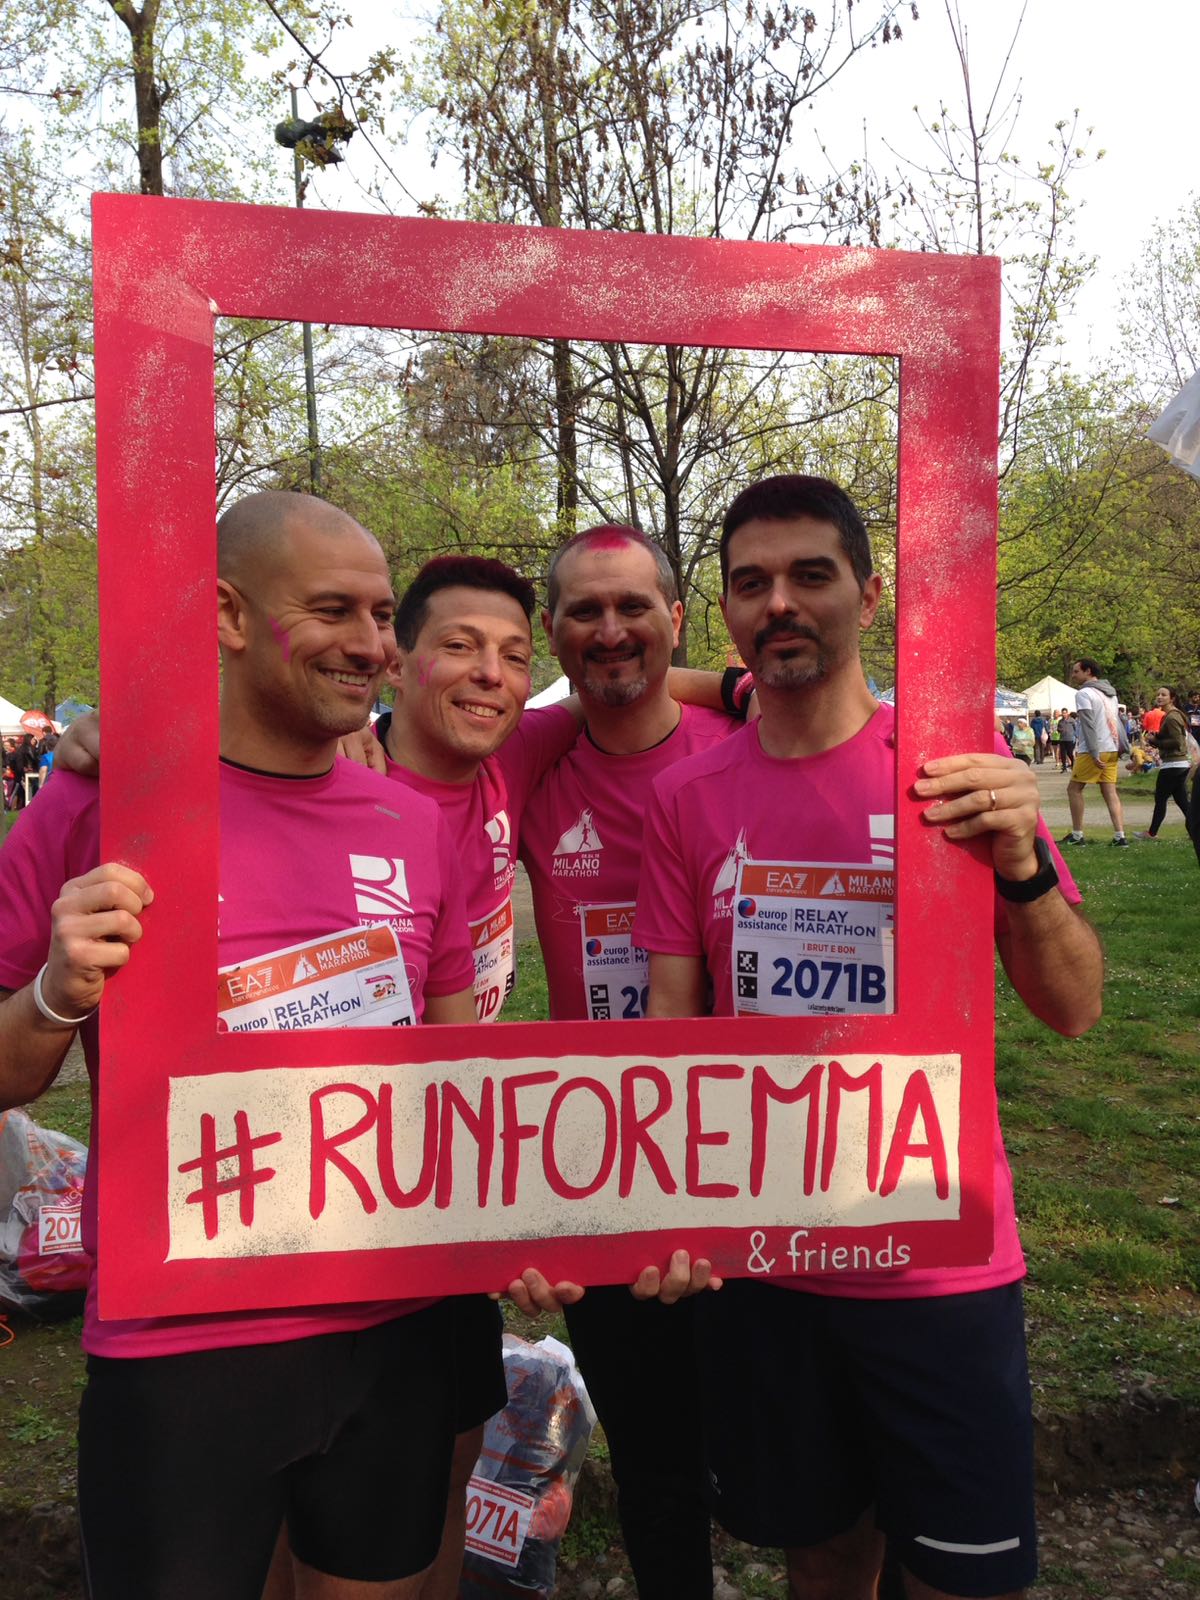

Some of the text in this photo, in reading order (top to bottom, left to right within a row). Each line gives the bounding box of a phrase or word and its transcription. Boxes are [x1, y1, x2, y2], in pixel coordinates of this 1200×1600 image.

[553, 858, 600, 870] MILANO
[551, 869, 599, 877] MARATHON
[766, 872, 808, 890] EA7
[849, 875, 894, 889] MILAN
[848, 886, 893, 896] MARATHO
[606, 911, 636, 928] EA
[758, 909, 788, 922] europ
[794, 908, 848, 923] RELAY
[737, 918, 788, 932] assistance
[794, 921, 876, 938] MARATHON
[316, 938, 367, 964] MILANO
[604, 946, 629, 957] europ
[807, 943, 829, 952] BRUT
[319, 949, 370, 971] MARATHON
[474, 952, 489, 967] LAY
[475, 958, 498, 975] ATHON
[587, 956, 630, 966] assistance
[227, 966, 273, 997] EA7
[771, 957, 886, 1004] 2071B
[274, 991, 330, 1020] RELAY
[278, 996, 361, 1031] MARATHON
[232, 1015, 268, 1031] europ
[177, 1060, 949, 1240] #RUNFOREMMA
[44, 1216, 81, 1242] 207
[747, 1230, 911, 1273] & friends
[466, 1495, 519, 1547] 071A
